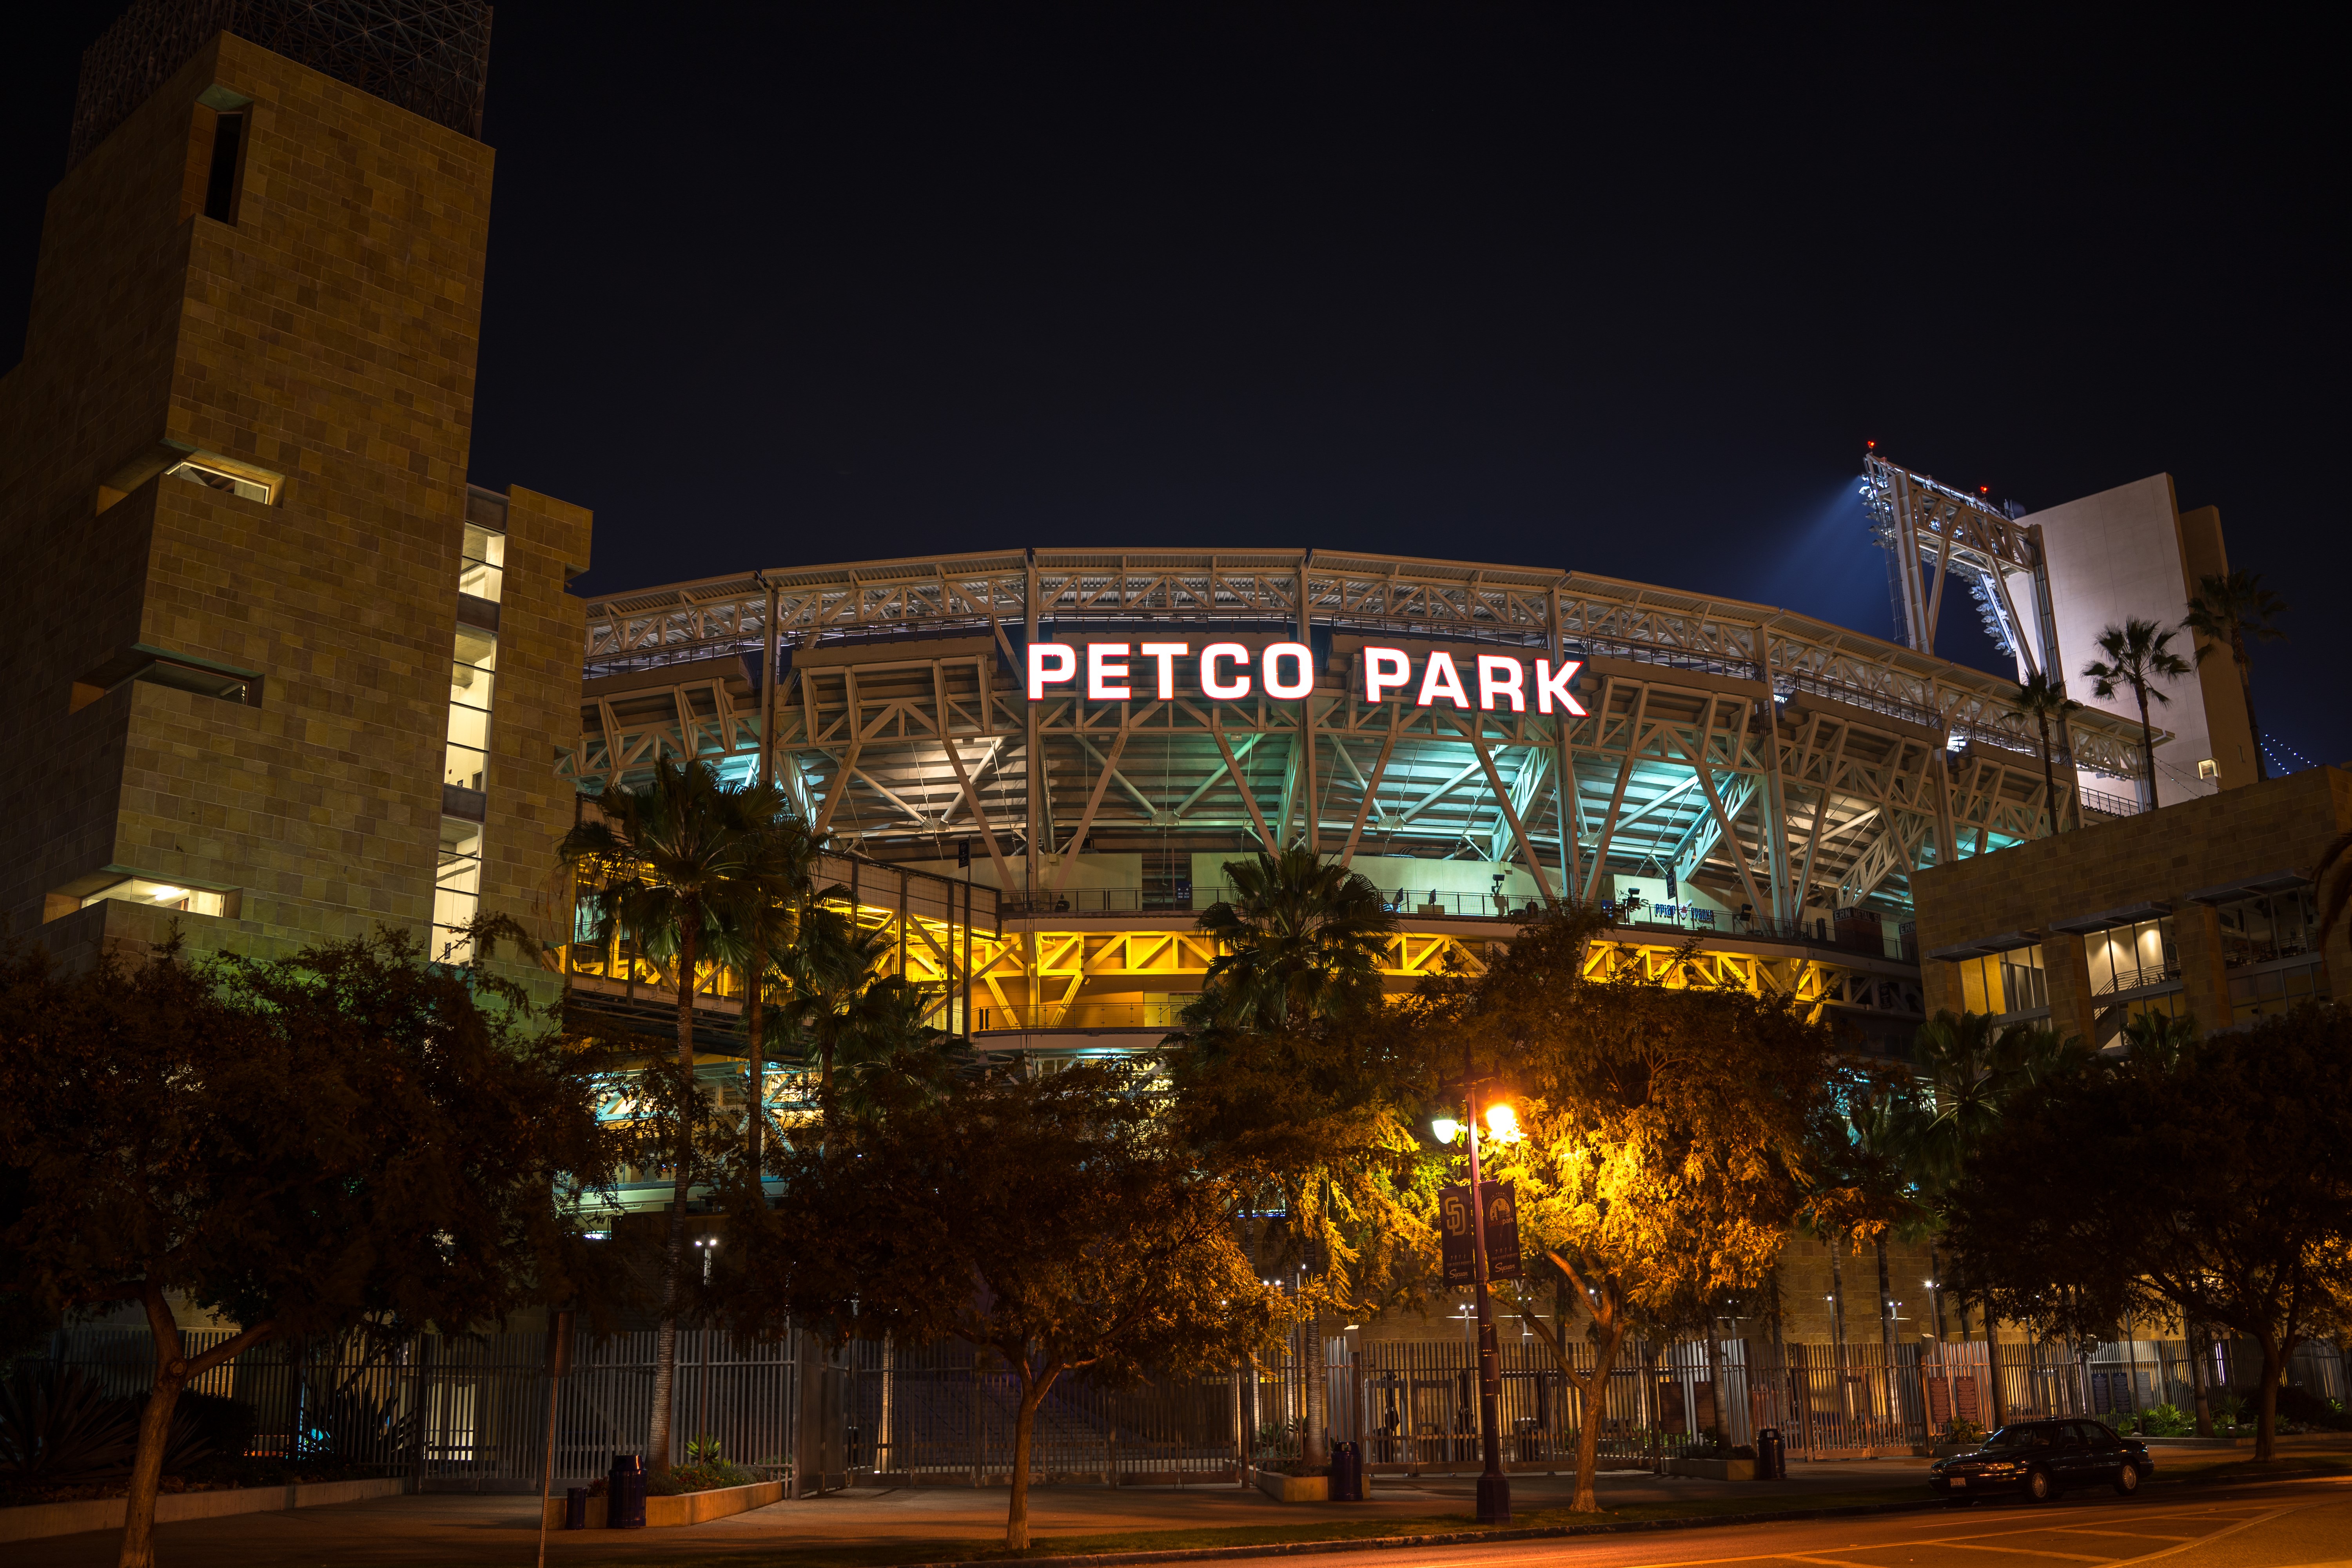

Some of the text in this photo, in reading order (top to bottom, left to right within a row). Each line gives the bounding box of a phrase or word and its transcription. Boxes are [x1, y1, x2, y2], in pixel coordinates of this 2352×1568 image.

[1026, 641, 1591, 718] PETCO PARK
[1834, 908, 1851, 920] ERN
[1853, 909, 1871, 921] METAL
[1900, 922, 1916, 933] ERN
[1495, 1262, 1515, 1273] Sycuan
[1449, 1269, 1468, 1279] Sycuan
